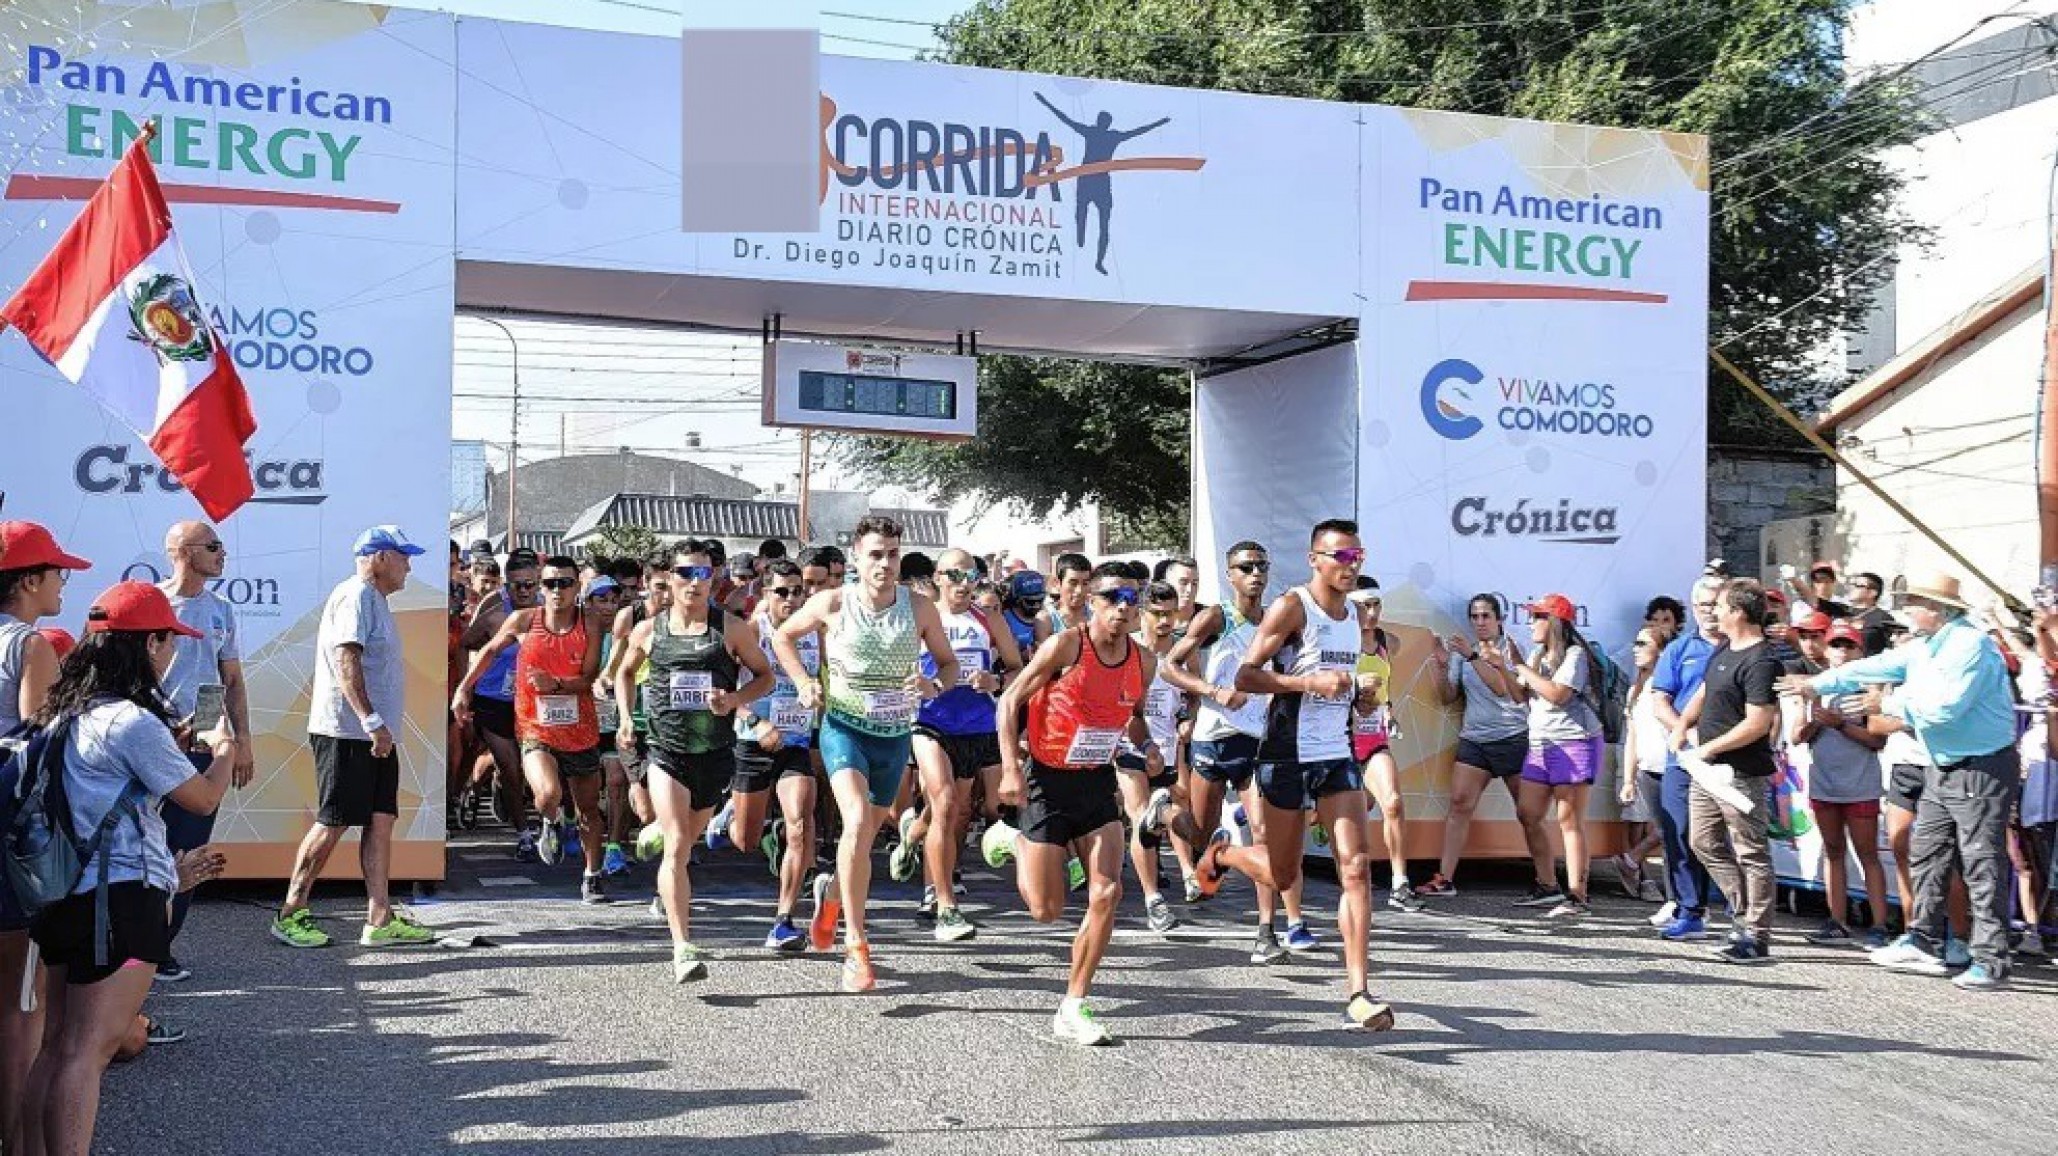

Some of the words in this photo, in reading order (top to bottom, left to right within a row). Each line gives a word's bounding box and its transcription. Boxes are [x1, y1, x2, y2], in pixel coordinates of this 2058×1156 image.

[28, 45, 125, 94] Pan
[139, 61, 391, 124] American
[67, 104, 361, 181] ENERGY
[836, 114, 1062, 202] CORRIDA
[839, 193, 1062, 229] INTERNACIONAL
[1420, 178, 1482, 214] Pan
[1492, 185, 1662, 230] American
[838, 220, 931, 246] DIARIO
[945, 226, 1062, 255] CRÓNICA
[1445, 223, 1641, 279] ENERGY
[734, 238, 770, 261] Dr.
[785, 241, 860, 269] Diego
[873, 248, 975, 275] Joaquín
[989, 255, 1061, 279] Zamit
[1498, 377, 1615, 409] VIVAMOS
[1498, 406, 1654, 438] COMODORO
[1452, 497, 1618, 536] Crónica
